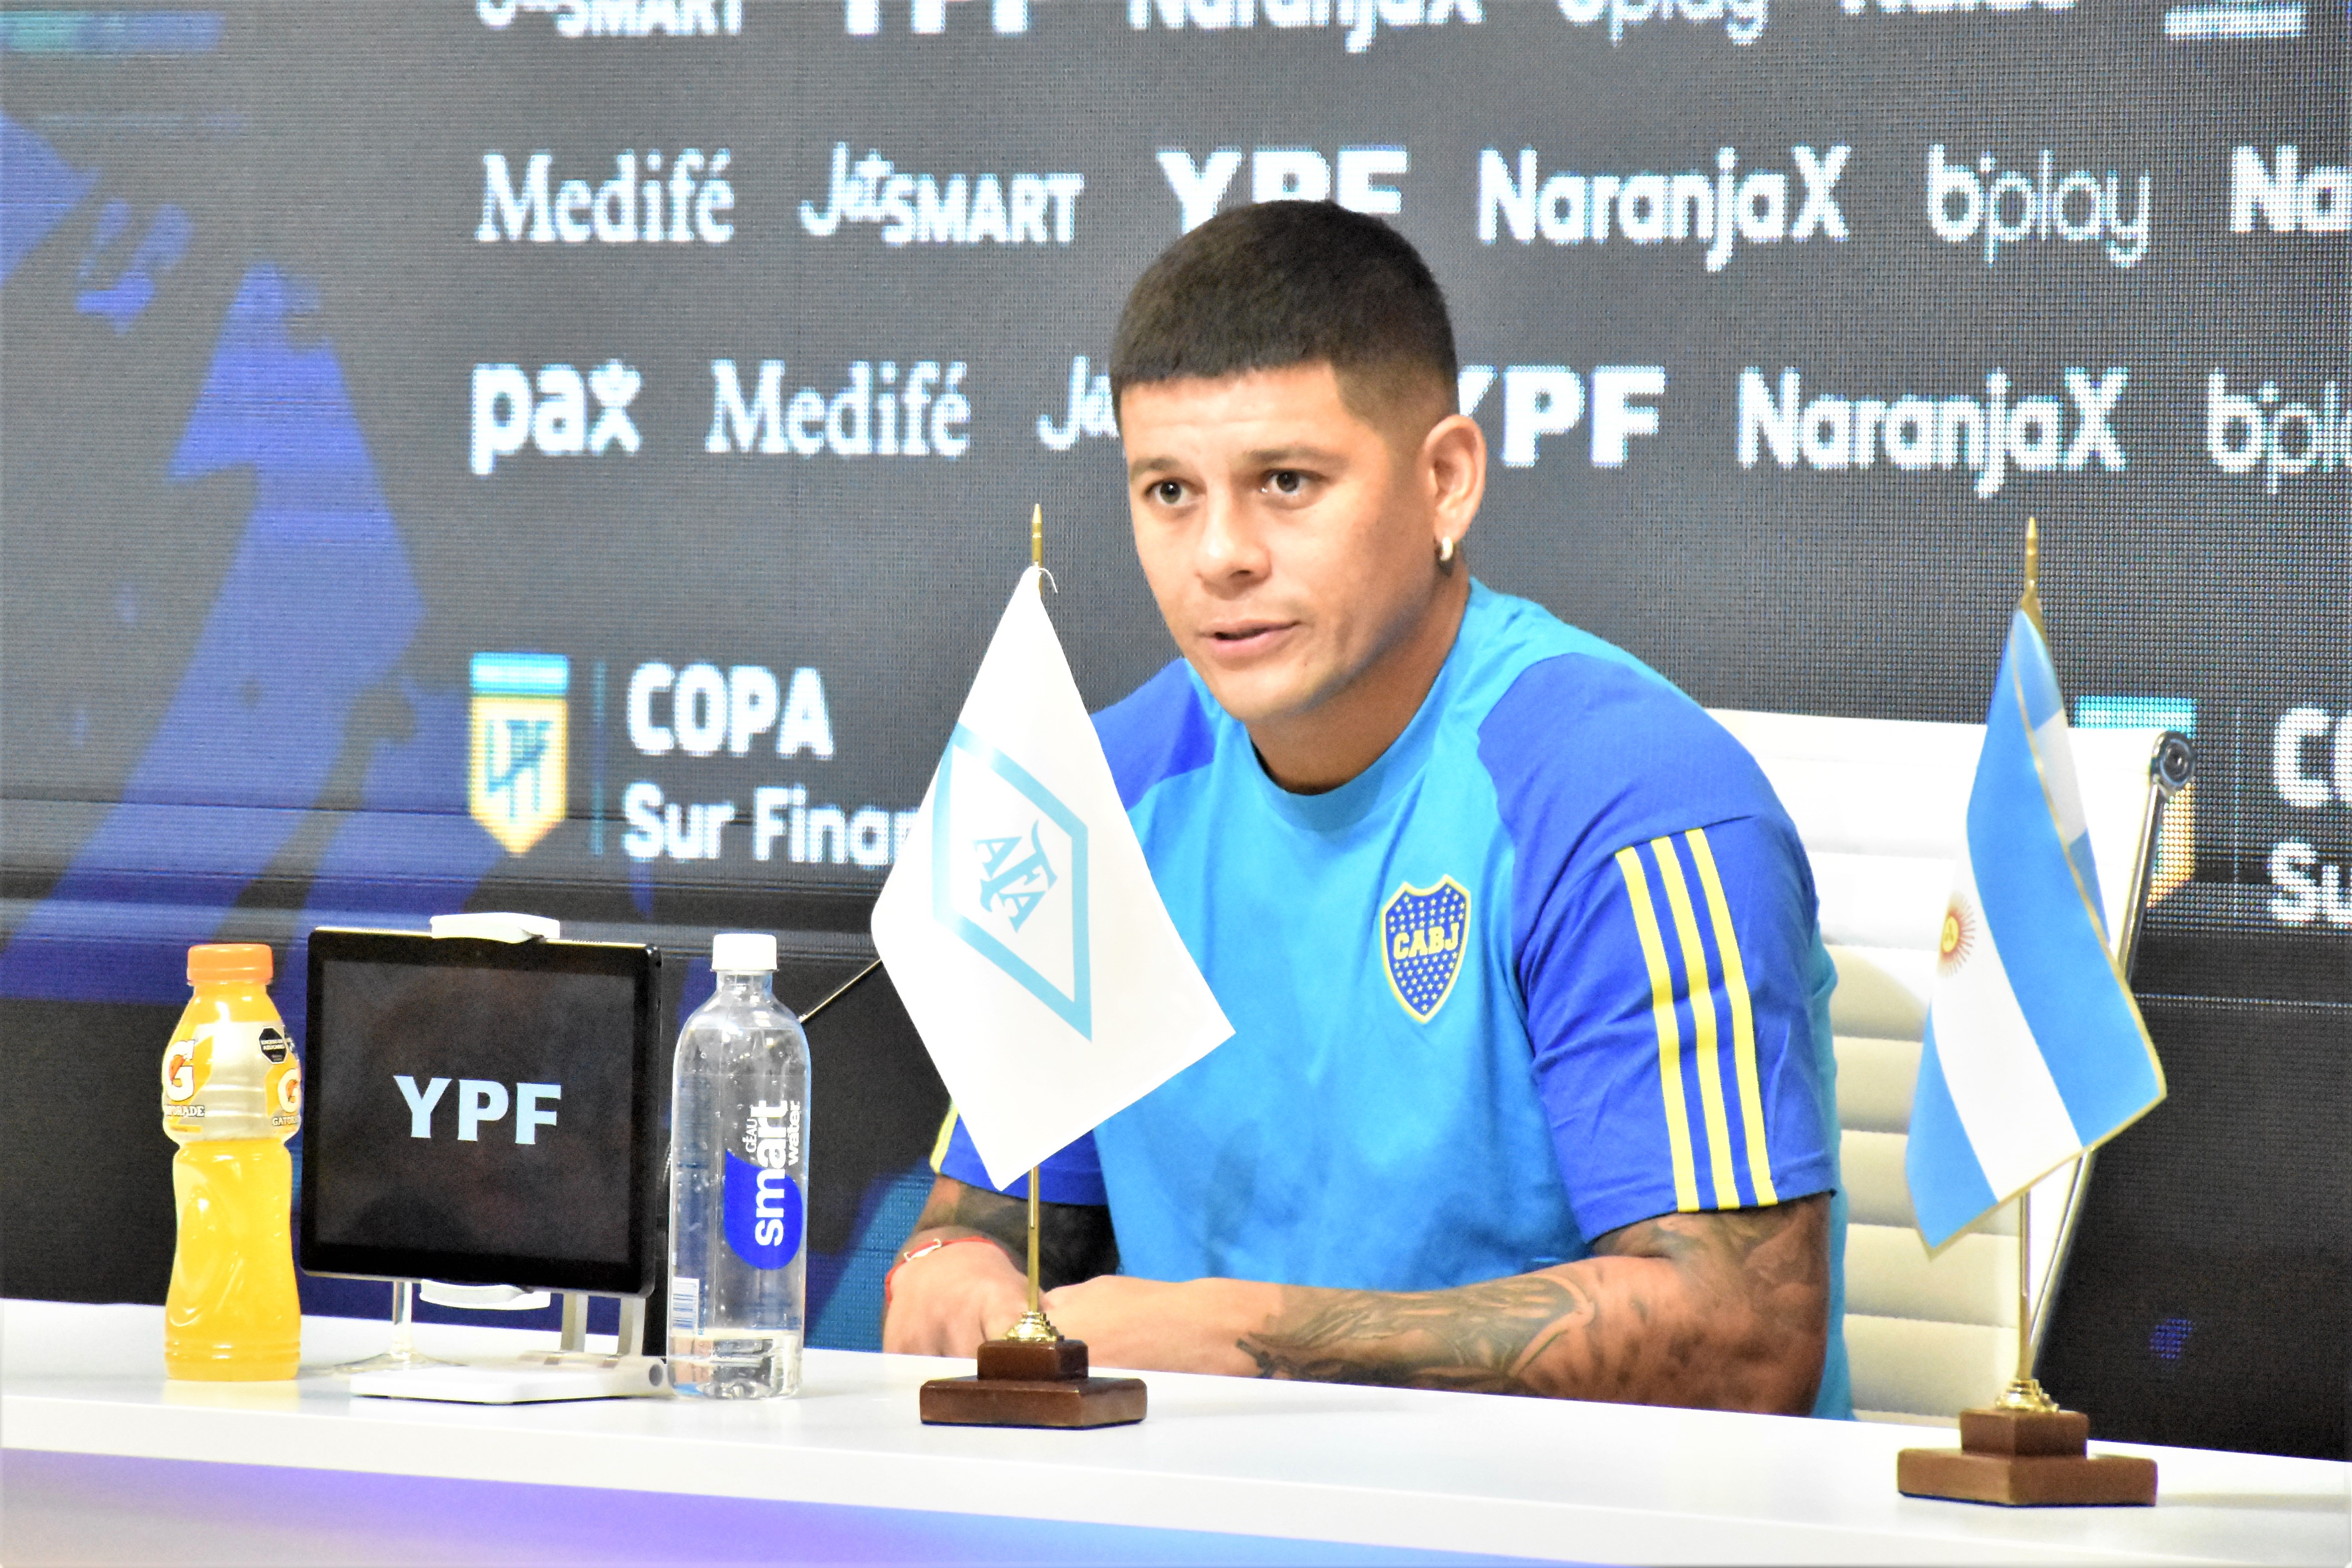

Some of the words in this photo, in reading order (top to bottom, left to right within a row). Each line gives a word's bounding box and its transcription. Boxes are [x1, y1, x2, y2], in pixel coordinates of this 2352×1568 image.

[476, 149, 735, 243] Medifé
[799, 142, 1085, 246] JetSMART
[1478, 144, 1851, 273] NaranjaX
[1927, 143, 2150, 267] bplay
[471, 359, 642, 477] pax
[705, 358, 972, 457] Medifé
[1738, 367, 2128, 498] NaranjaX
[626, 661, 835, 760] COPA
[623, 780, 735, 863] Sur
[1393, 922, 1460, 960] CABJ
[393, 1075, 562, 1145] YPF
[750, 1100, 787, 1246] smart
